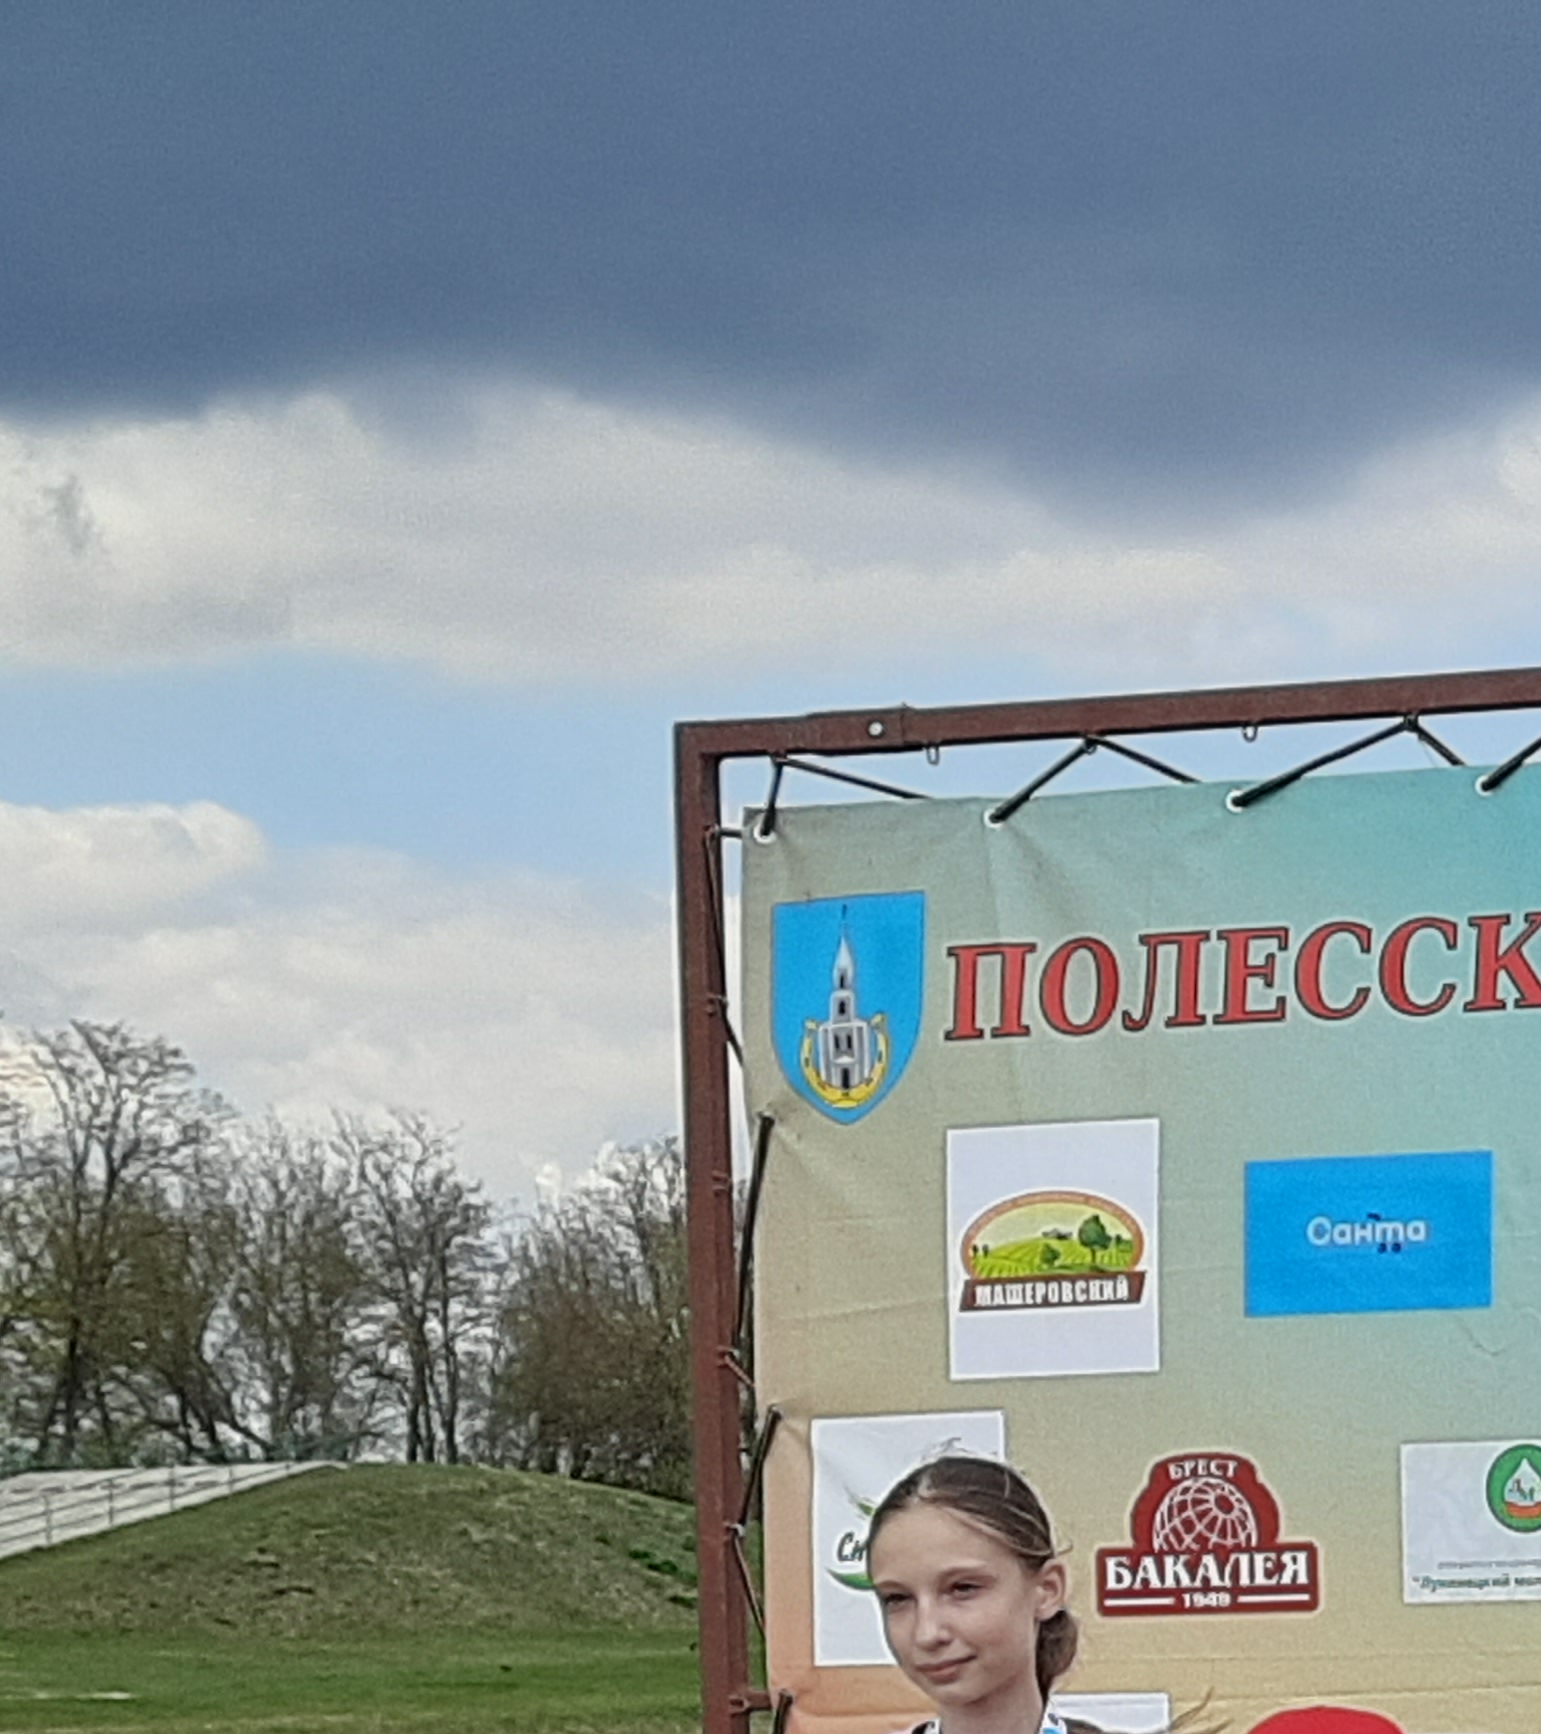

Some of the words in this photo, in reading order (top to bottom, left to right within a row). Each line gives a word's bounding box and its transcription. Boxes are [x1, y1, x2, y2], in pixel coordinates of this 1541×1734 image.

[1306, 1216, 1427, 1246] Санта
[974, 1276, 1130, 1308] МАШЕРОВСКИЙ
[1168, 1459, 1238, 1479] БРЕСТ
[1105, 1551, 1309, 1590] БАКАЛЕЯ
